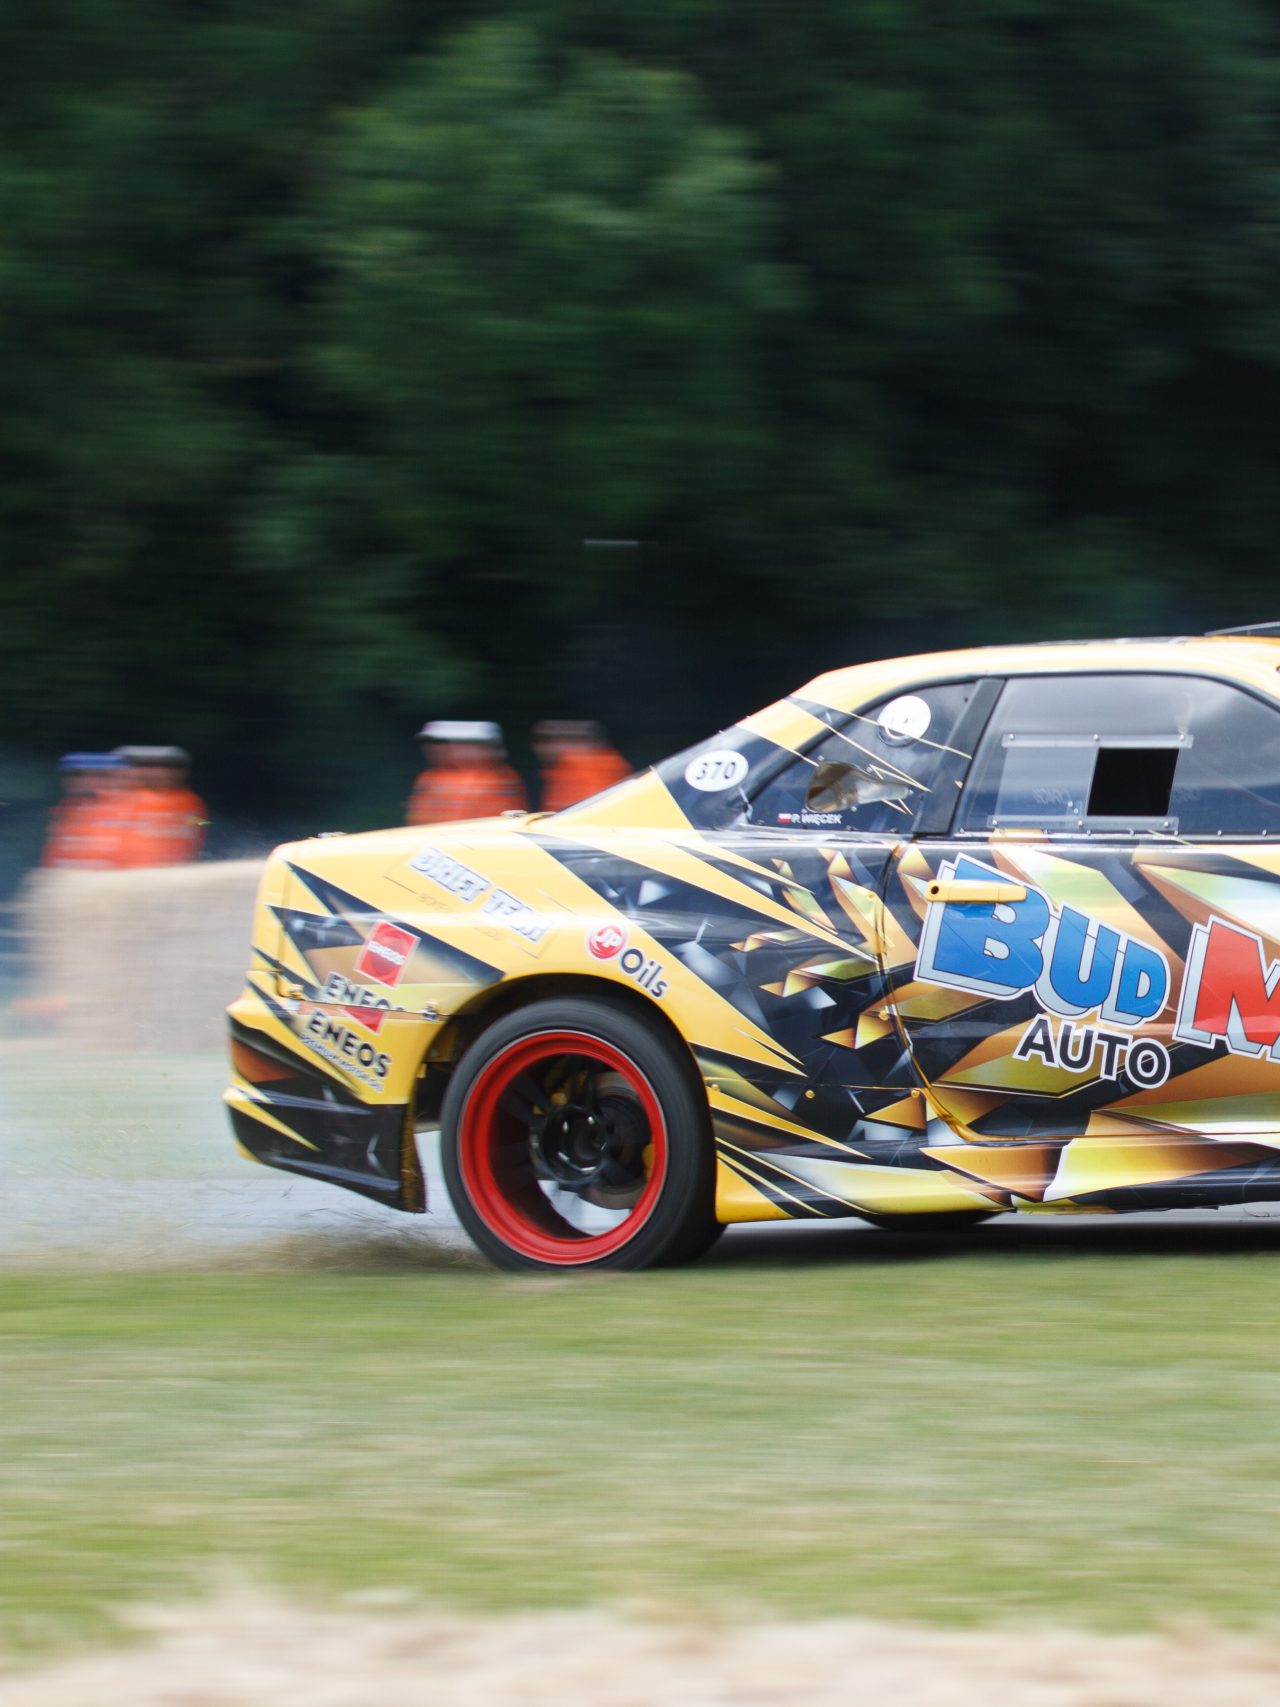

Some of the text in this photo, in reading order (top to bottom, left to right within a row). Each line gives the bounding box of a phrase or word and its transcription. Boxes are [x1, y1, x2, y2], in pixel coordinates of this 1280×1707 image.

[621, 948, 667, 997] Oils
[308, 1009, 391, 1078] ENEOS
[1016, 1017, 1169, 1086] AUTO
